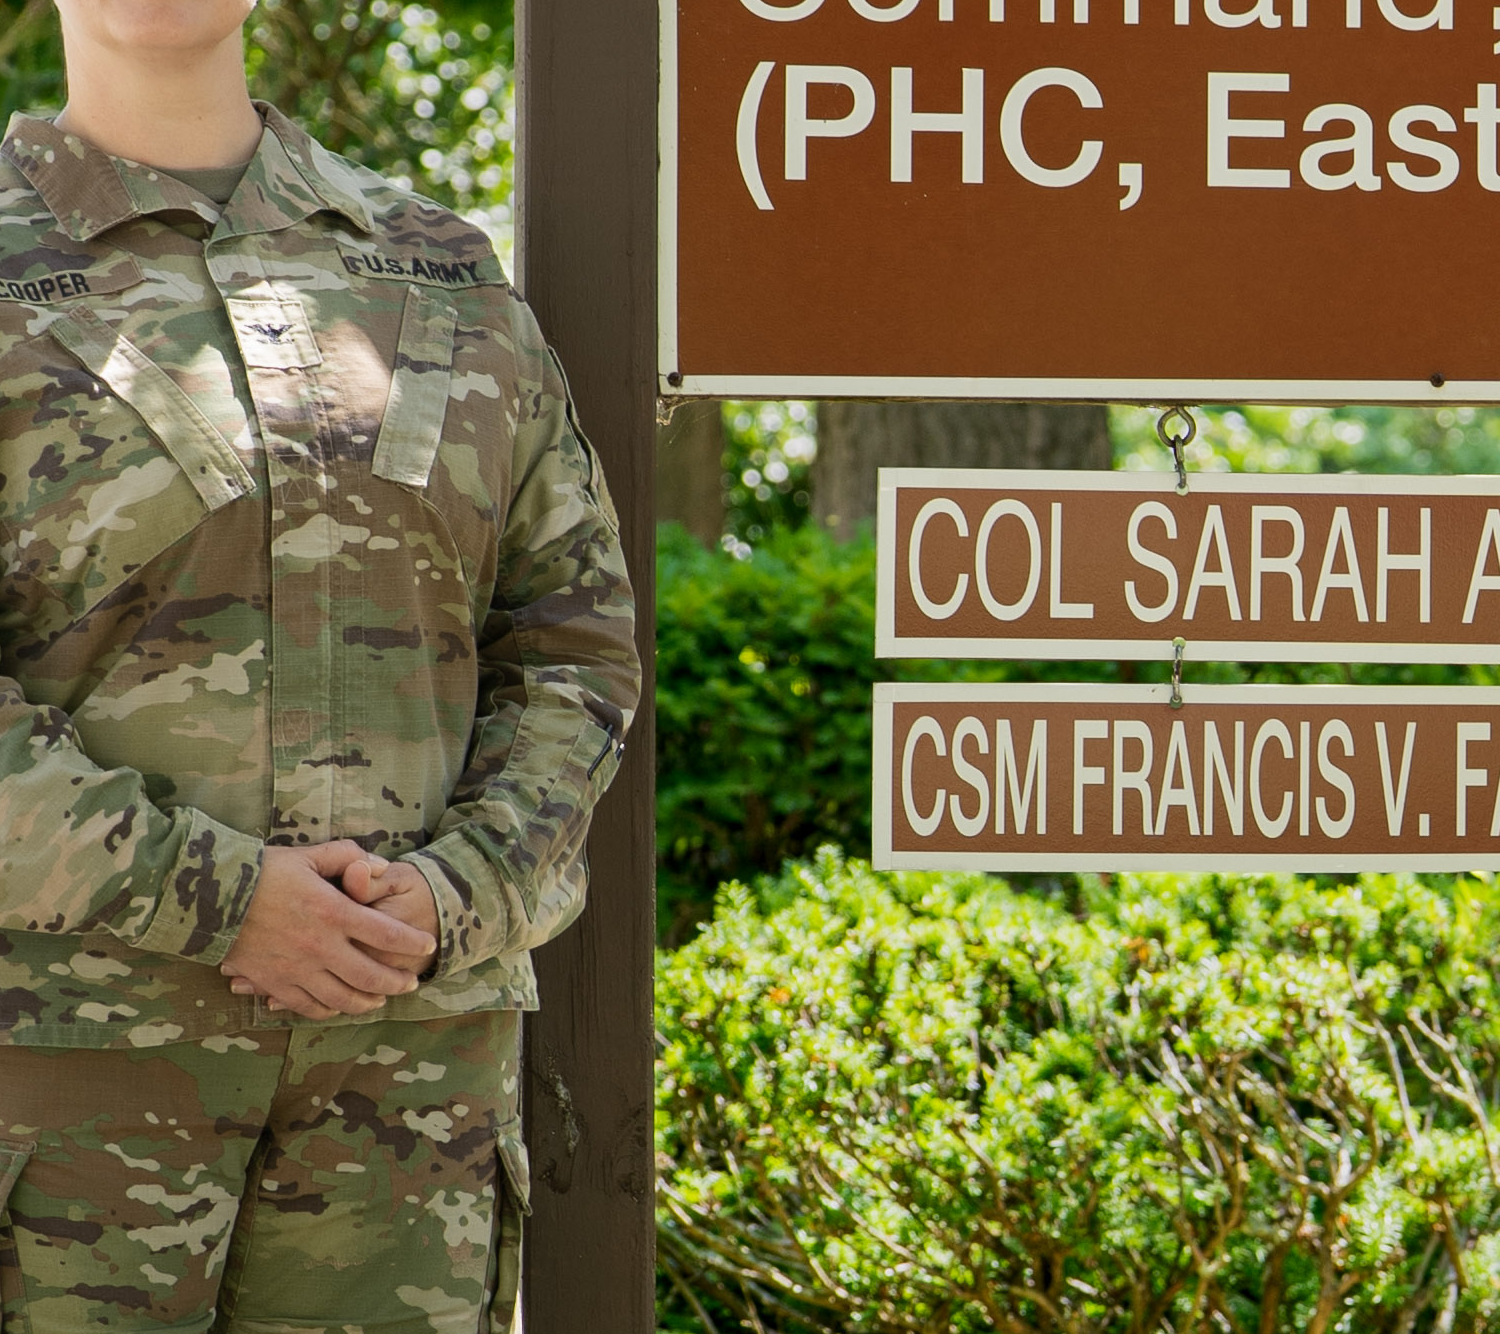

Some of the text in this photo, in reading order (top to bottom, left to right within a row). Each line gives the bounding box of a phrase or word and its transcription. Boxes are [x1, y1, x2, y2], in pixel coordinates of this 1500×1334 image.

[737, 62, 1142, 210] (PHC,
[909, 498, 1093, 621] COL
[1125, 501, 1431, 622] SARAH
[902, 716, 1047, 836] CSM
[1074, 719, 1355, 838] FRANCIS
[1375, 722, 1429, 836] V.
